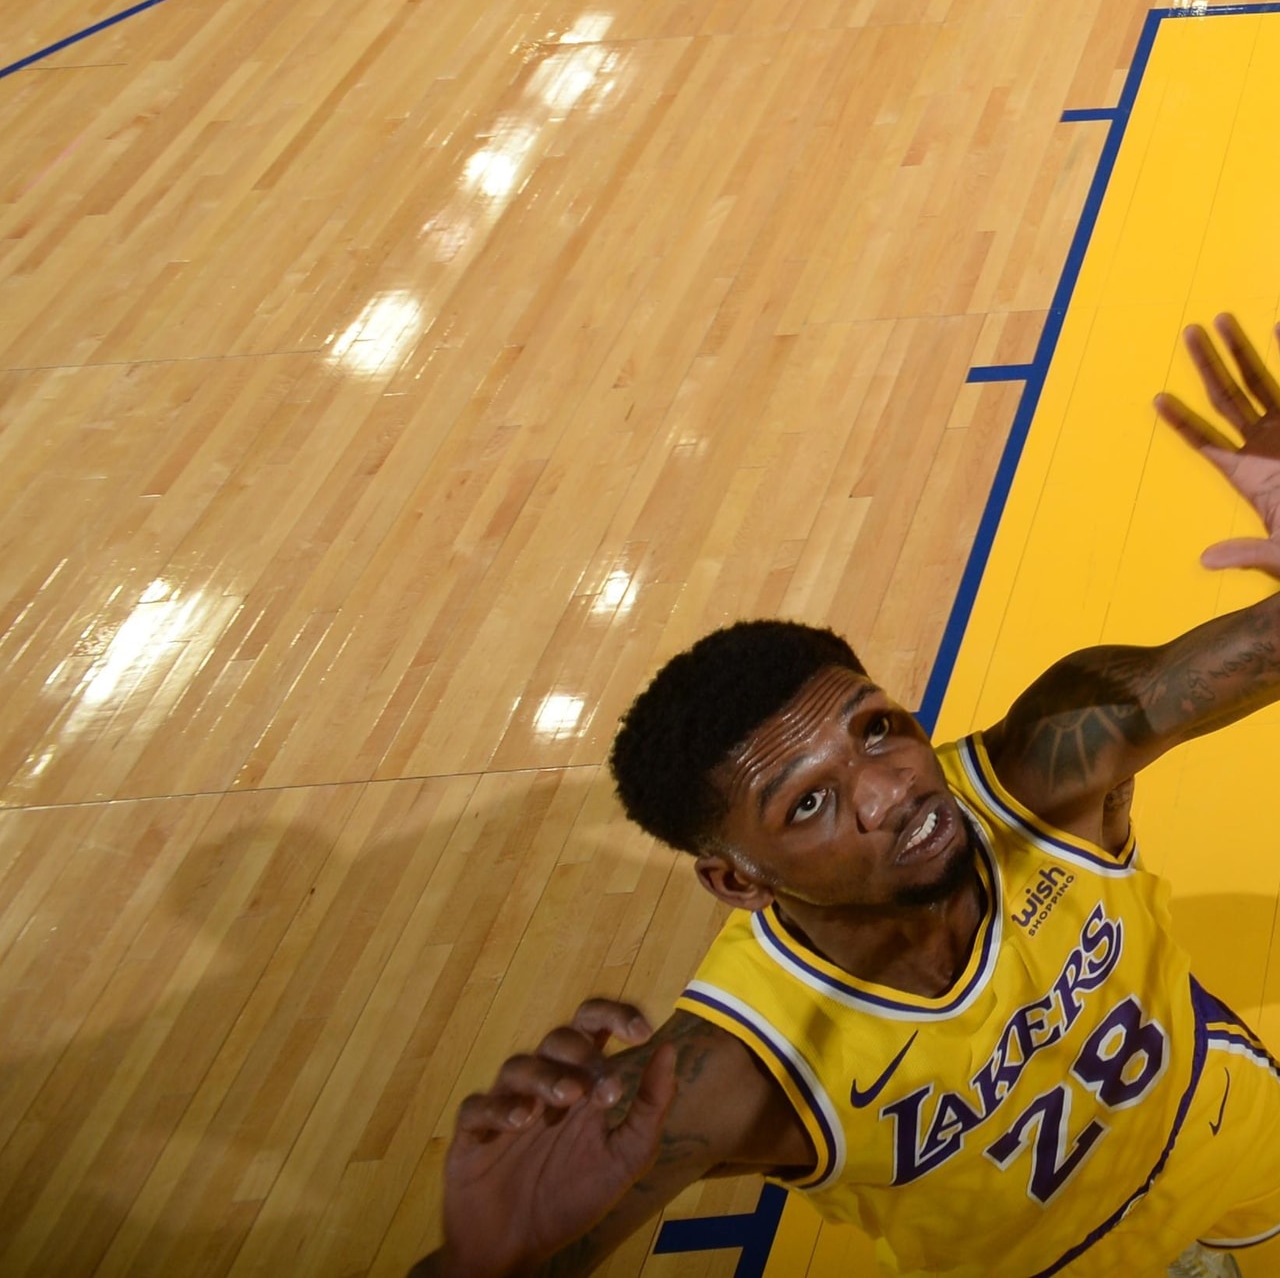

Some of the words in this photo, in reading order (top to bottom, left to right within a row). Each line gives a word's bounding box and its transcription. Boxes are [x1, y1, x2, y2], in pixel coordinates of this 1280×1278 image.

[1011, 866, 1066, 927] wish
[1028, 875, 1074, 936] SHOPPING
[879, 900, 1124, 1187] LAKERS
[983, 993, 1171, 1208] 28
